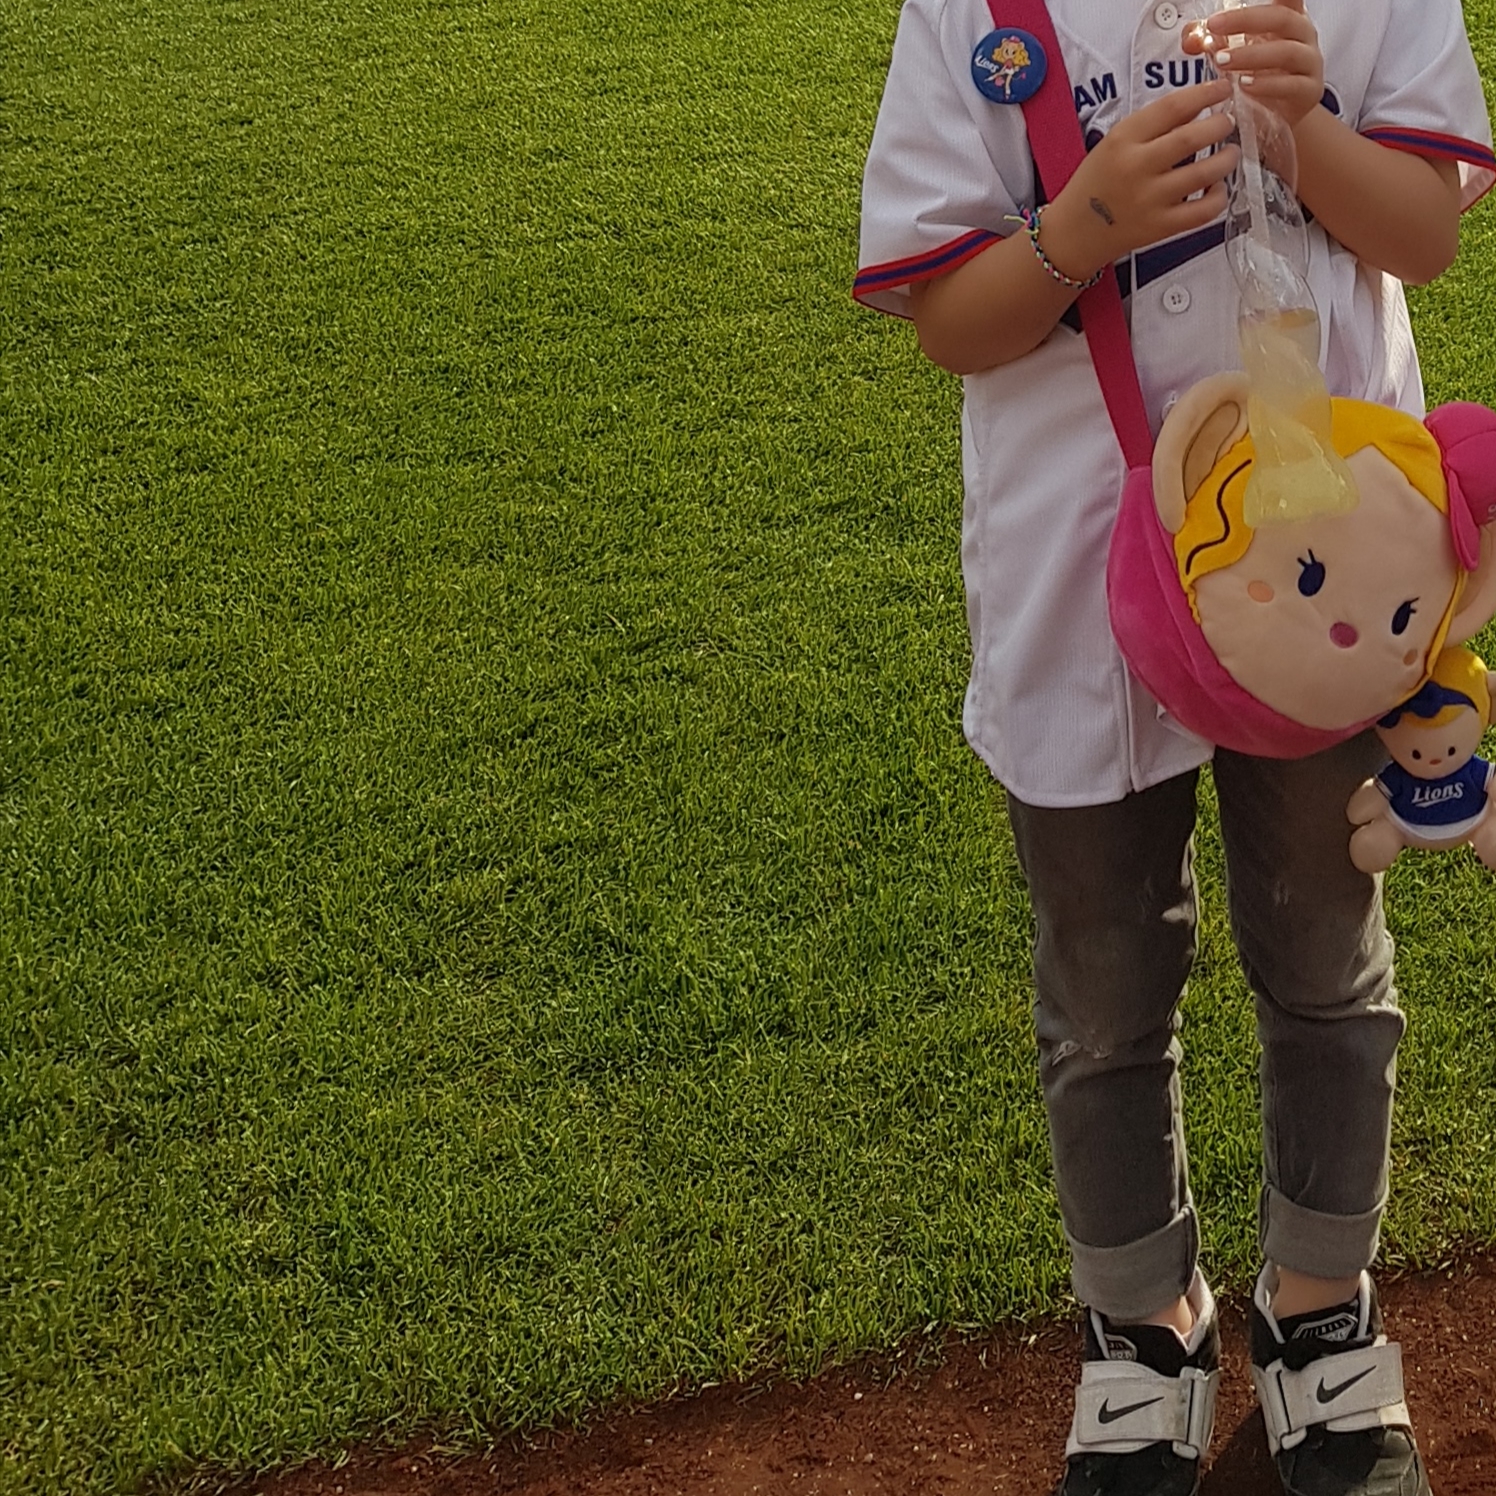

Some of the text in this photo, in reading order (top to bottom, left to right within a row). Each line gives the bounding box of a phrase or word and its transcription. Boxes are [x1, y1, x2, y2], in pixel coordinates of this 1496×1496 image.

[1074, 58, 1218, 113] AM SUN
[1411, 782, 1465, 808] Lions
